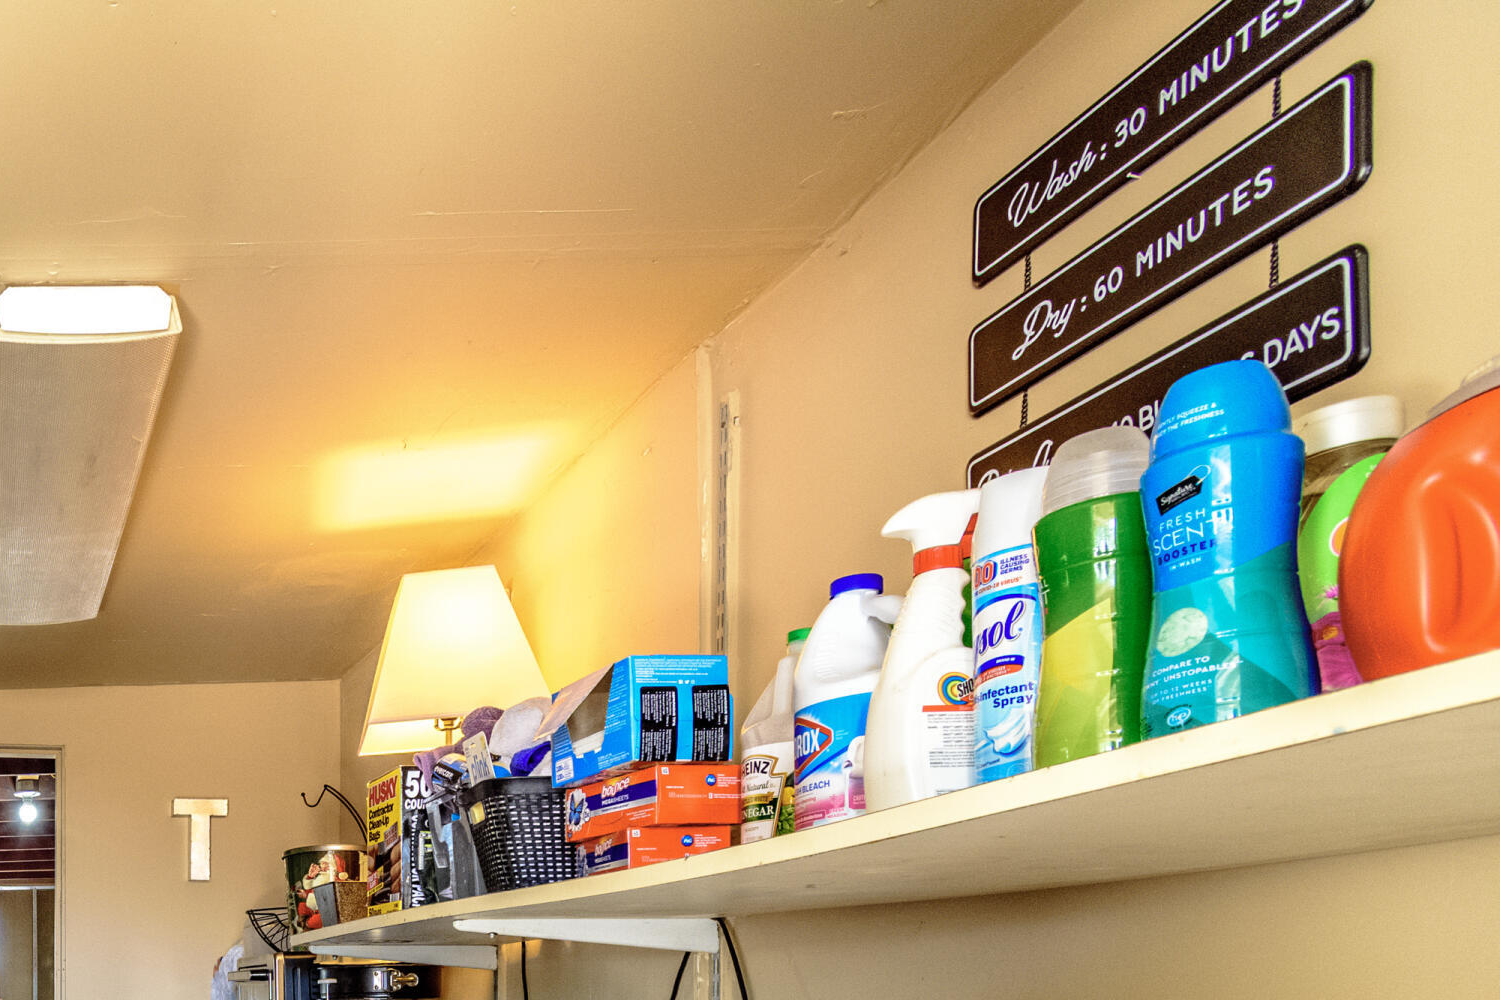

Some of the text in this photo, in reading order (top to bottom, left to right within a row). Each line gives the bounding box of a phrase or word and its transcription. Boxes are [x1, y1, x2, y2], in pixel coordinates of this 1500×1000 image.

[1114, 107, 1147, 146] 30
[1159, 0, 1305, 116] MINUTES
[1093, 266, 1124, 303] 60
[1136, 166, 1276, 278] MINUTES
[1263, 306, 1341, 369] DAYS
[1159, 508, 1206, 533] FRESH
[1153, 516, 1224, 556] SCENT
[1000, 559, 1030, 571] CAUSING
[1152, 655, 1211, 678] COMPARE TO
[956, 678, 975, 698] SHO
[975, 682, 1035, 703] sinfectant
[993, 694, 1033, 708] Spray
[795, 728, 821, 758] ROX
[368, 775, 398, 808] HUSKY
[601, 776, 630, 799] bounce
[802, 779, 830, 793] BLEACH
[368, 803, 394, 820] Contractor
[404, 798, 425, 810] COU
[742, 805, 775, 818] NEGAR
[368, 816, 390, 831] Clean-Up
[172, 798, 228, 881] T
[368, 830, 381, 842] Bags
